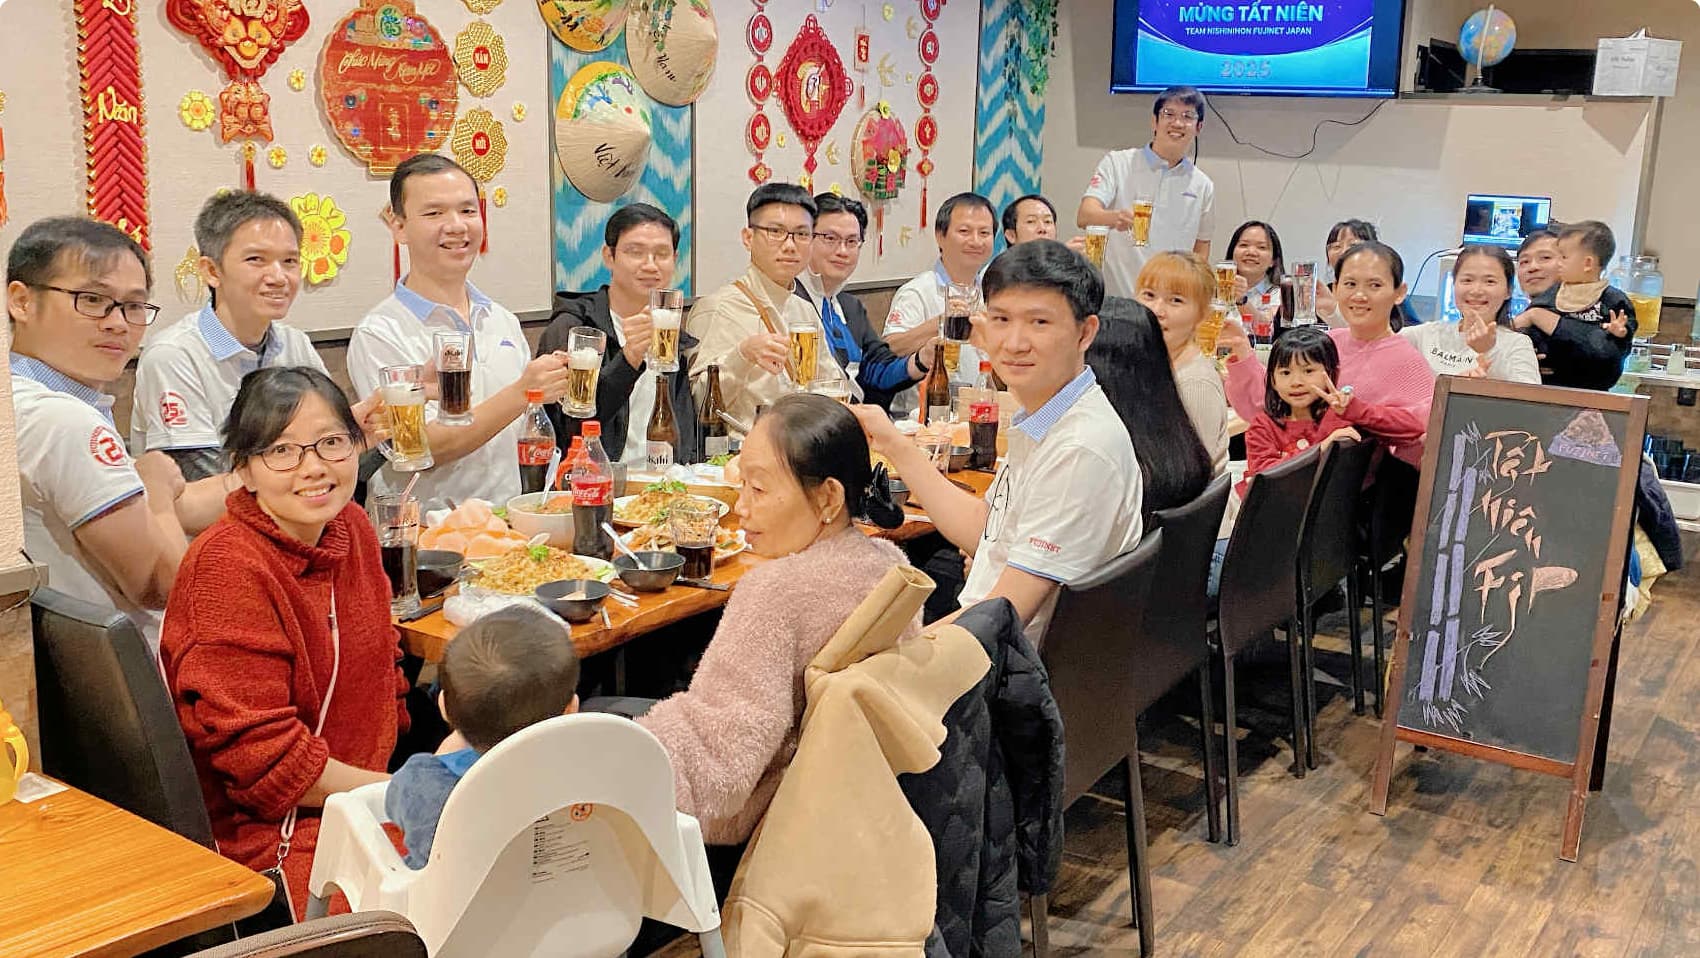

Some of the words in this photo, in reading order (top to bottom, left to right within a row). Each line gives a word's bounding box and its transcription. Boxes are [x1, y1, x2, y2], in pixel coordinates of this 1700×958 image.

[1275, 1, 1324, 22] NIÊN
[1186, 27, 1206, 35] TEAM
[1252, 27, 1284, 35] FUJINET
[1285, 27, 1312, 35] JAPAN
[1221, 59, 1273, 78] 2025
